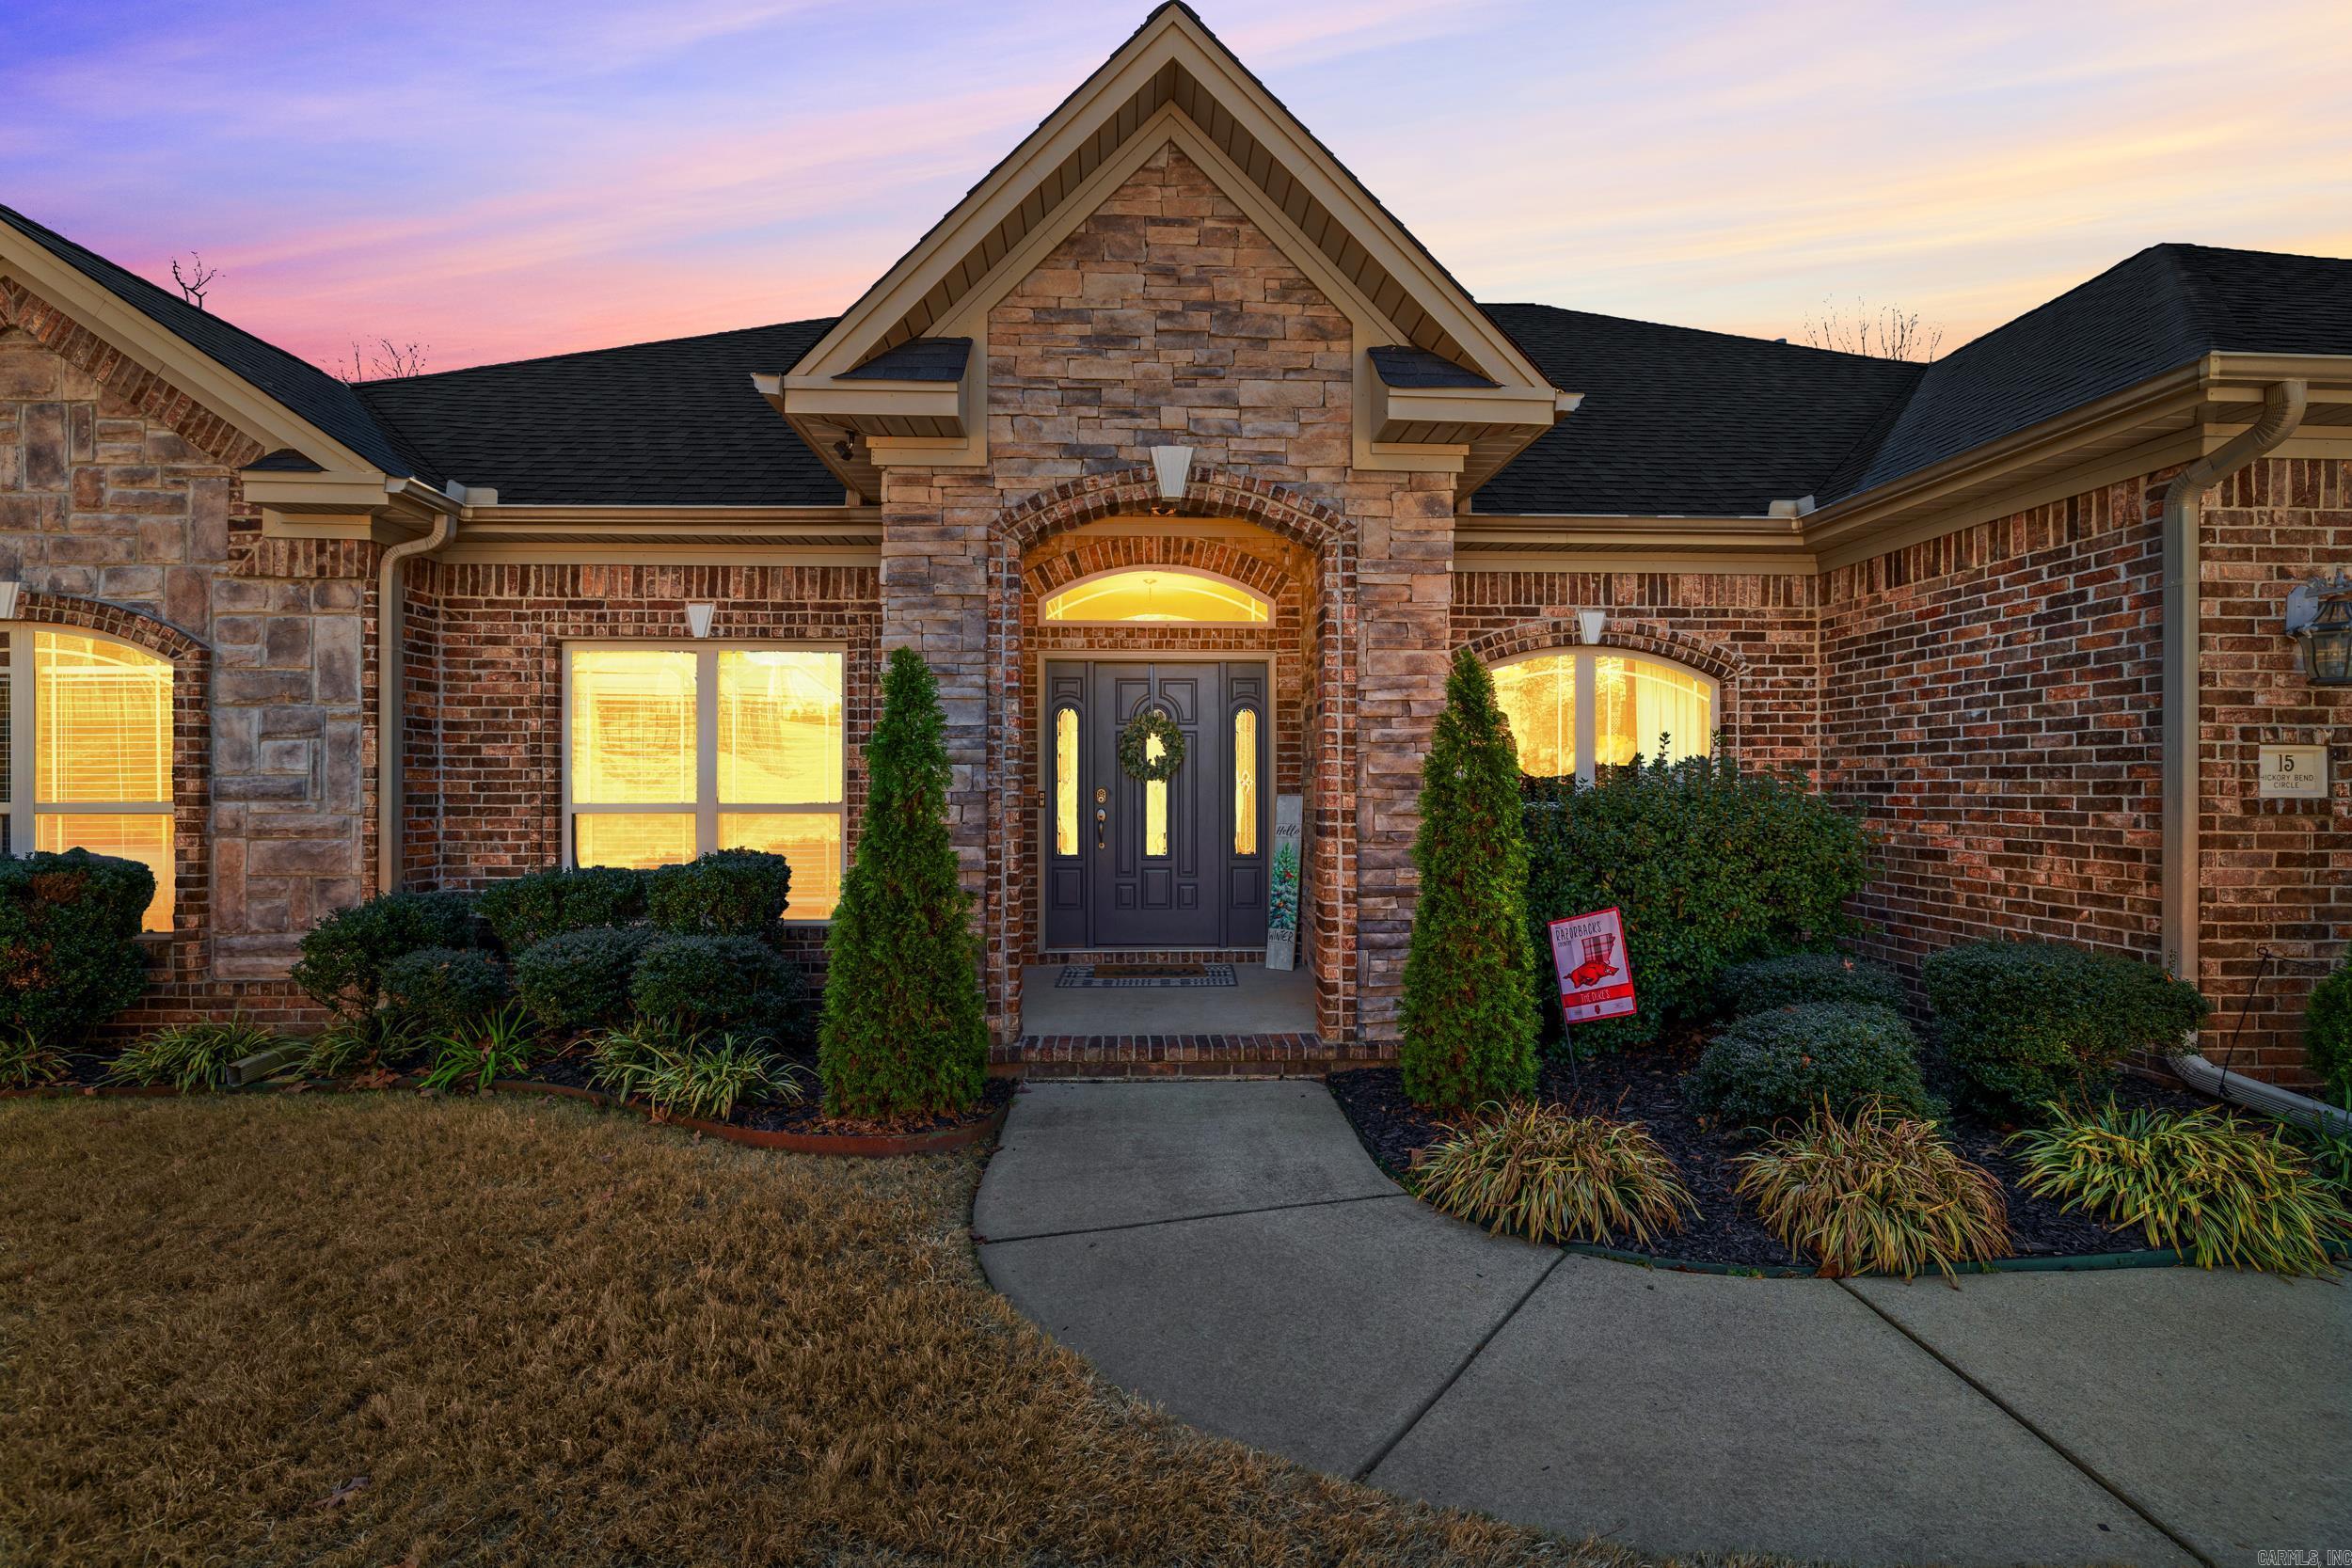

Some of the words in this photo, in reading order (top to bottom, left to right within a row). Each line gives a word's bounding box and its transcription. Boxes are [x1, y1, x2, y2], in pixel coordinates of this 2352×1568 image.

[2279, 754, 2295, 772] 15
[1276, 824, 1300, 837] Hello
[1268, 929, 1294, 943] WINTER
[1555, 920, 1602, 942] RAZORBACKS
[1581, 992, 1591, 1004] THE
